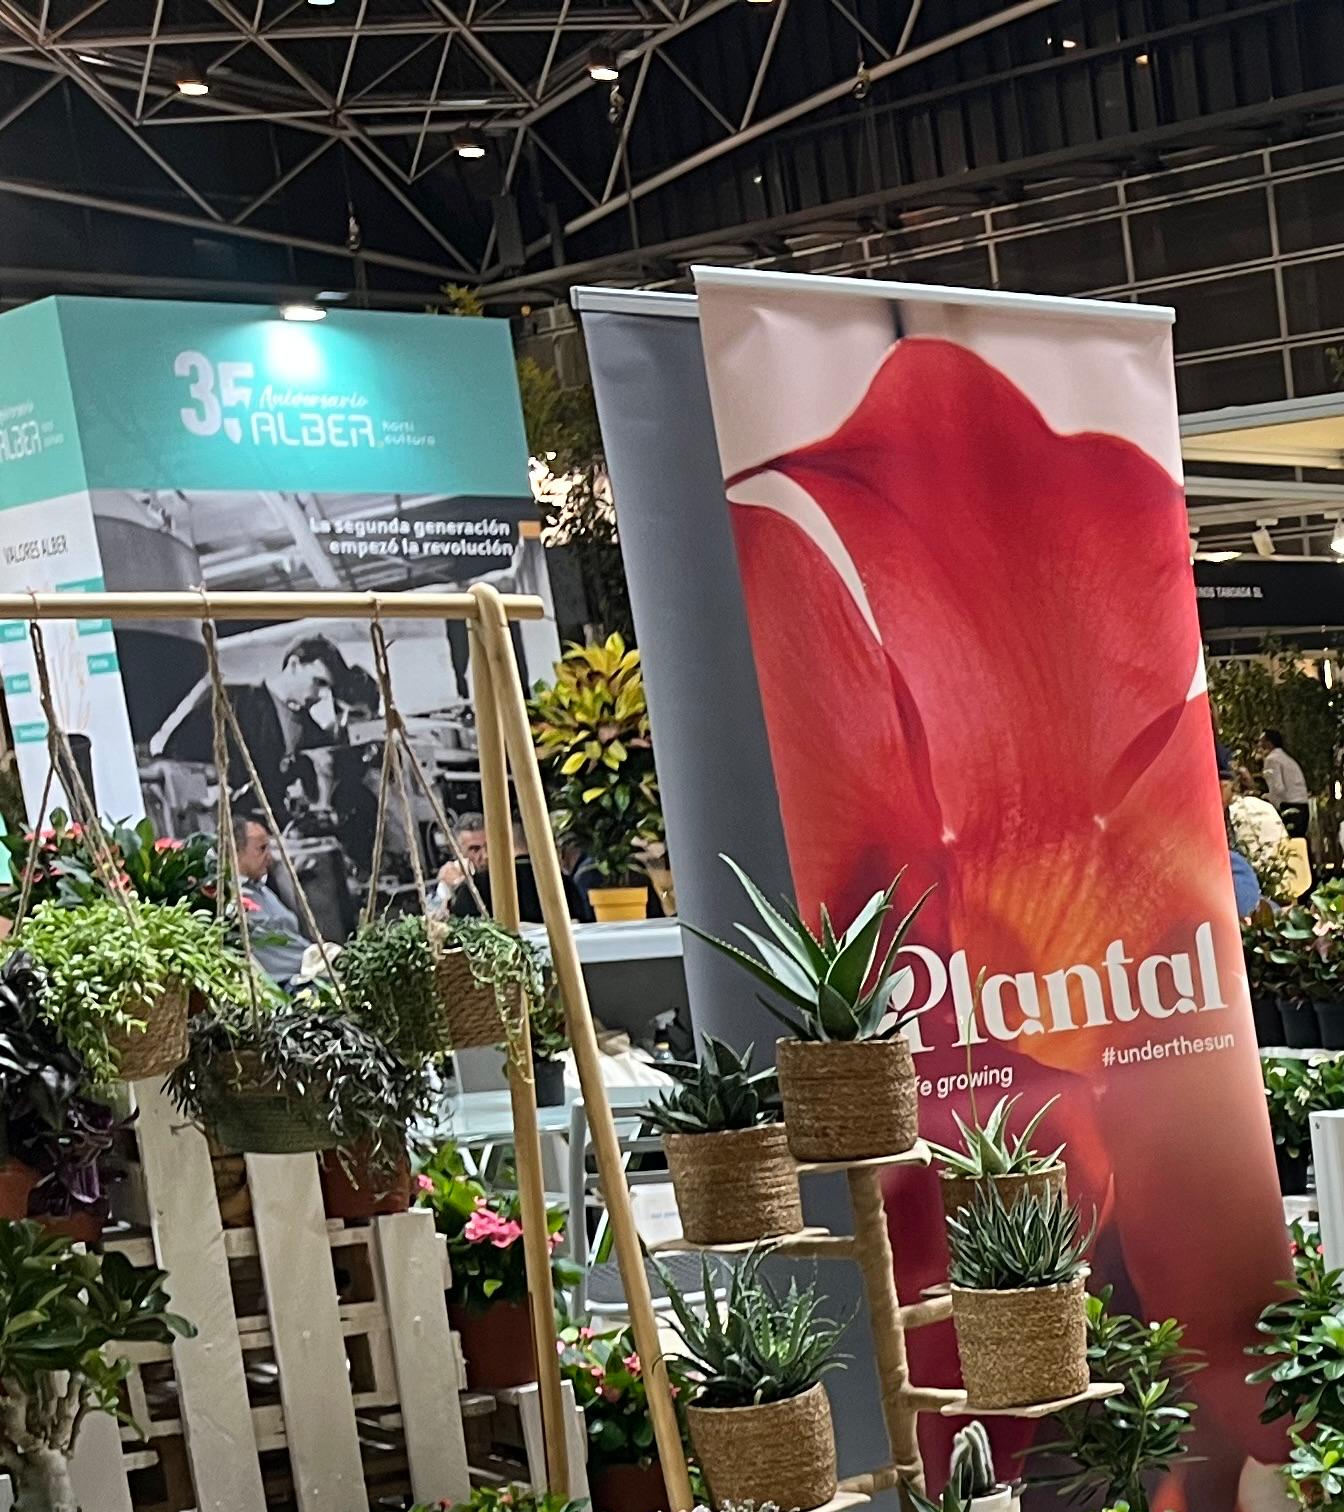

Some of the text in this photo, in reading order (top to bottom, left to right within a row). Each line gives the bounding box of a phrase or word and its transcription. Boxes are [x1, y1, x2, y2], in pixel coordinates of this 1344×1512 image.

[251, 412, 375, 448] ALBER
[309, 516, 510, 538] La segunda generación
[329, 537, 514, 558] empezó la revolución
[877, 920, 1228, 1055] Plantal
[937, 1065, 1013, 1099] growing
[1102, 1033, 1235, 1067] #underthesun
